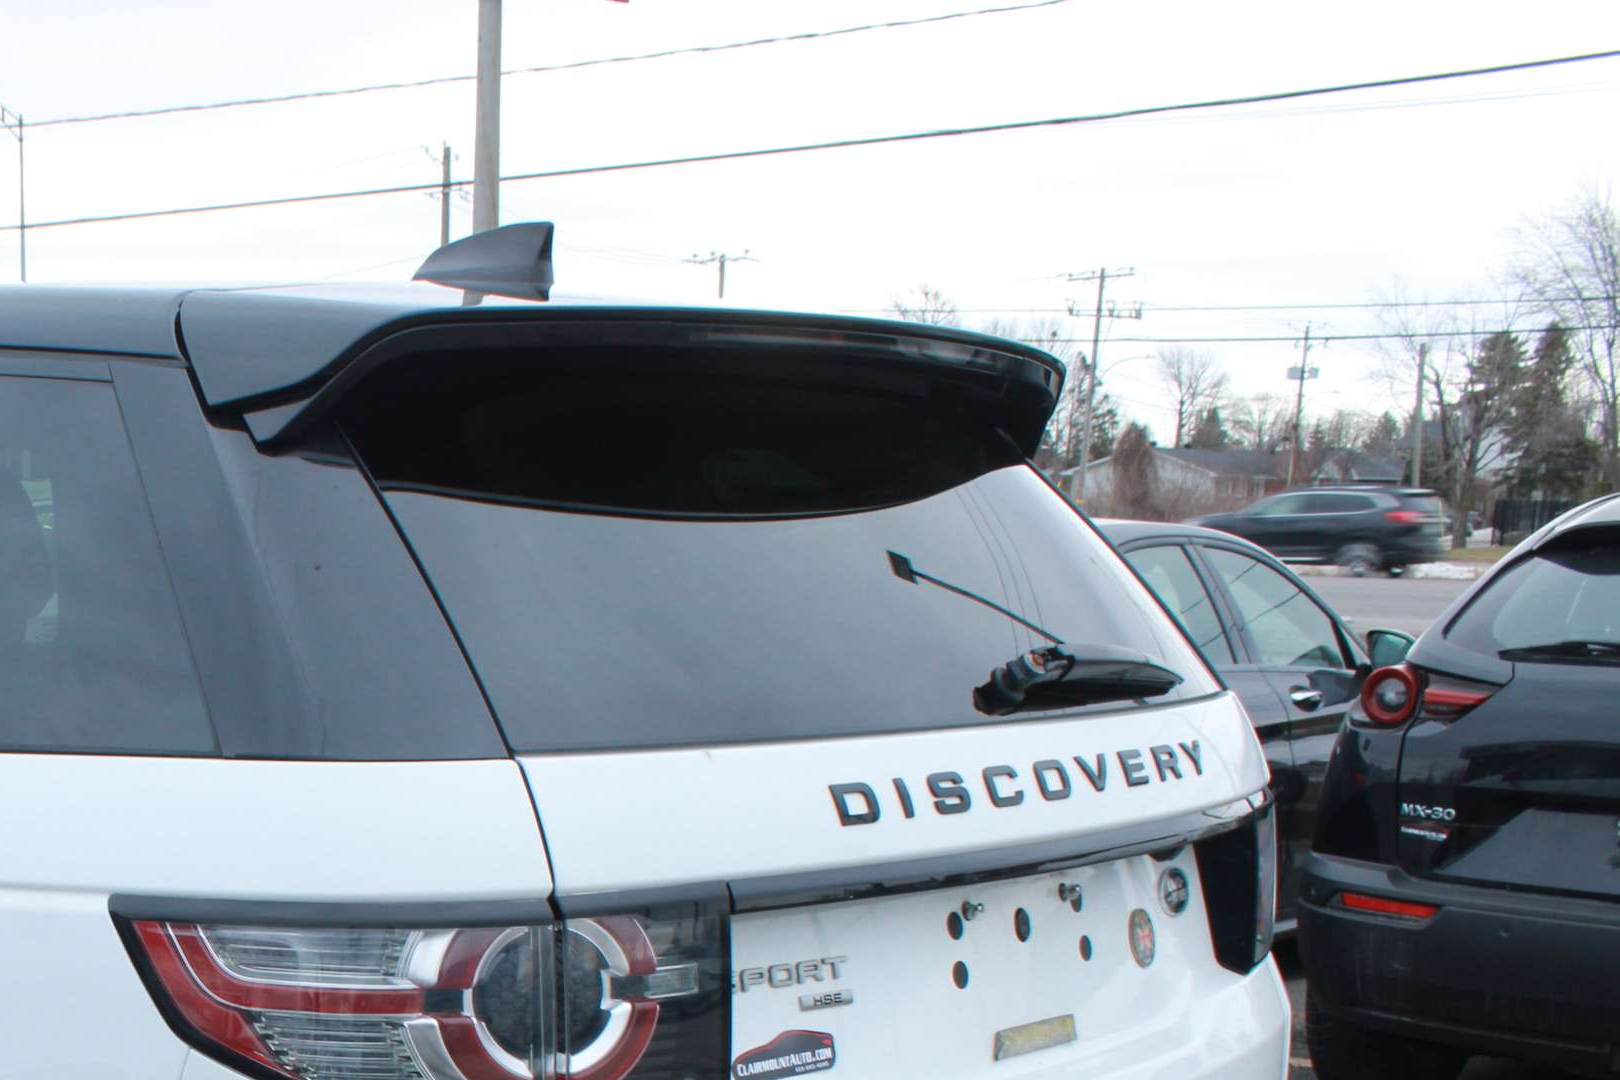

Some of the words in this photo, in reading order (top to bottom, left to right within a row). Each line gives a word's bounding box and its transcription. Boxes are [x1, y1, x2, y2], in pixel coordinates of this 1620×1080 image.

[828, 740, 1203, 827] DISCOVERY
[1401, 803, 1456, 821] MX-30
[731, 955, 848, 993] PORT
[812, 992, 844, 1008] HSE
